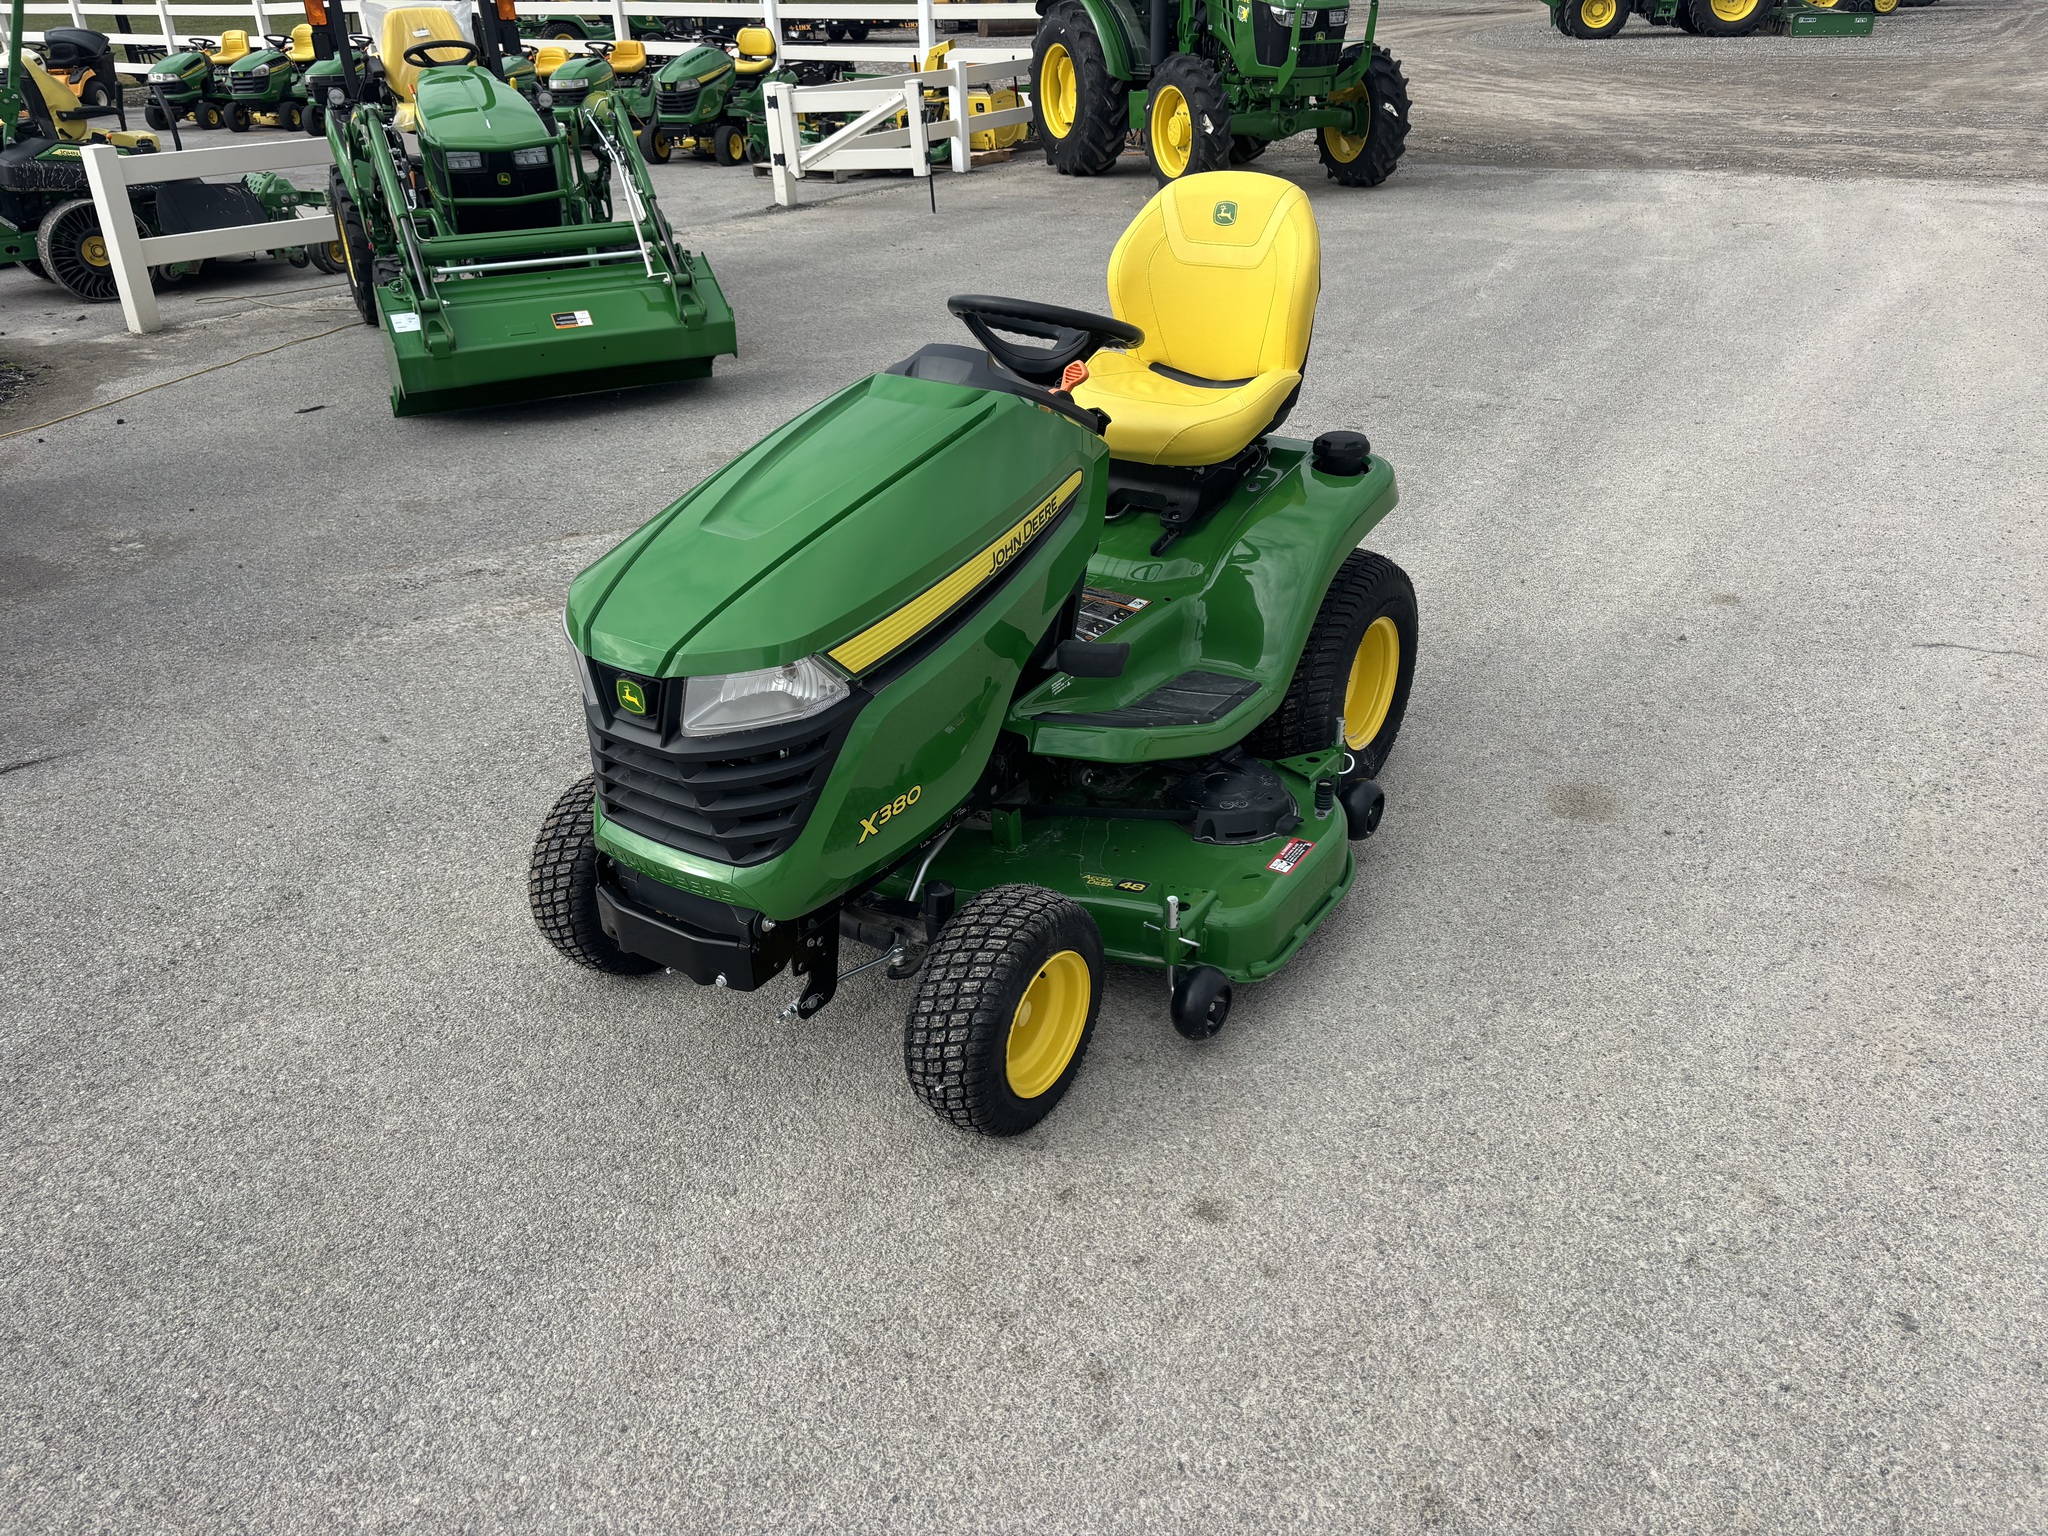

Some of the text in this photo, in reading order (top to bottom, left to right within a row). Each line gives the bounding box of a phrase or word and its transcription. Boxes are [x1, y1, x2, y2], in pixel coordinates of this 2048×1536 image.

[989, 495, 1058, 573] JOHN DEERE
[857, 785, 922, 846] X380
[1082, 874, 1113, 883] ACCEL
[1118, 881, 1146, 891] 48
